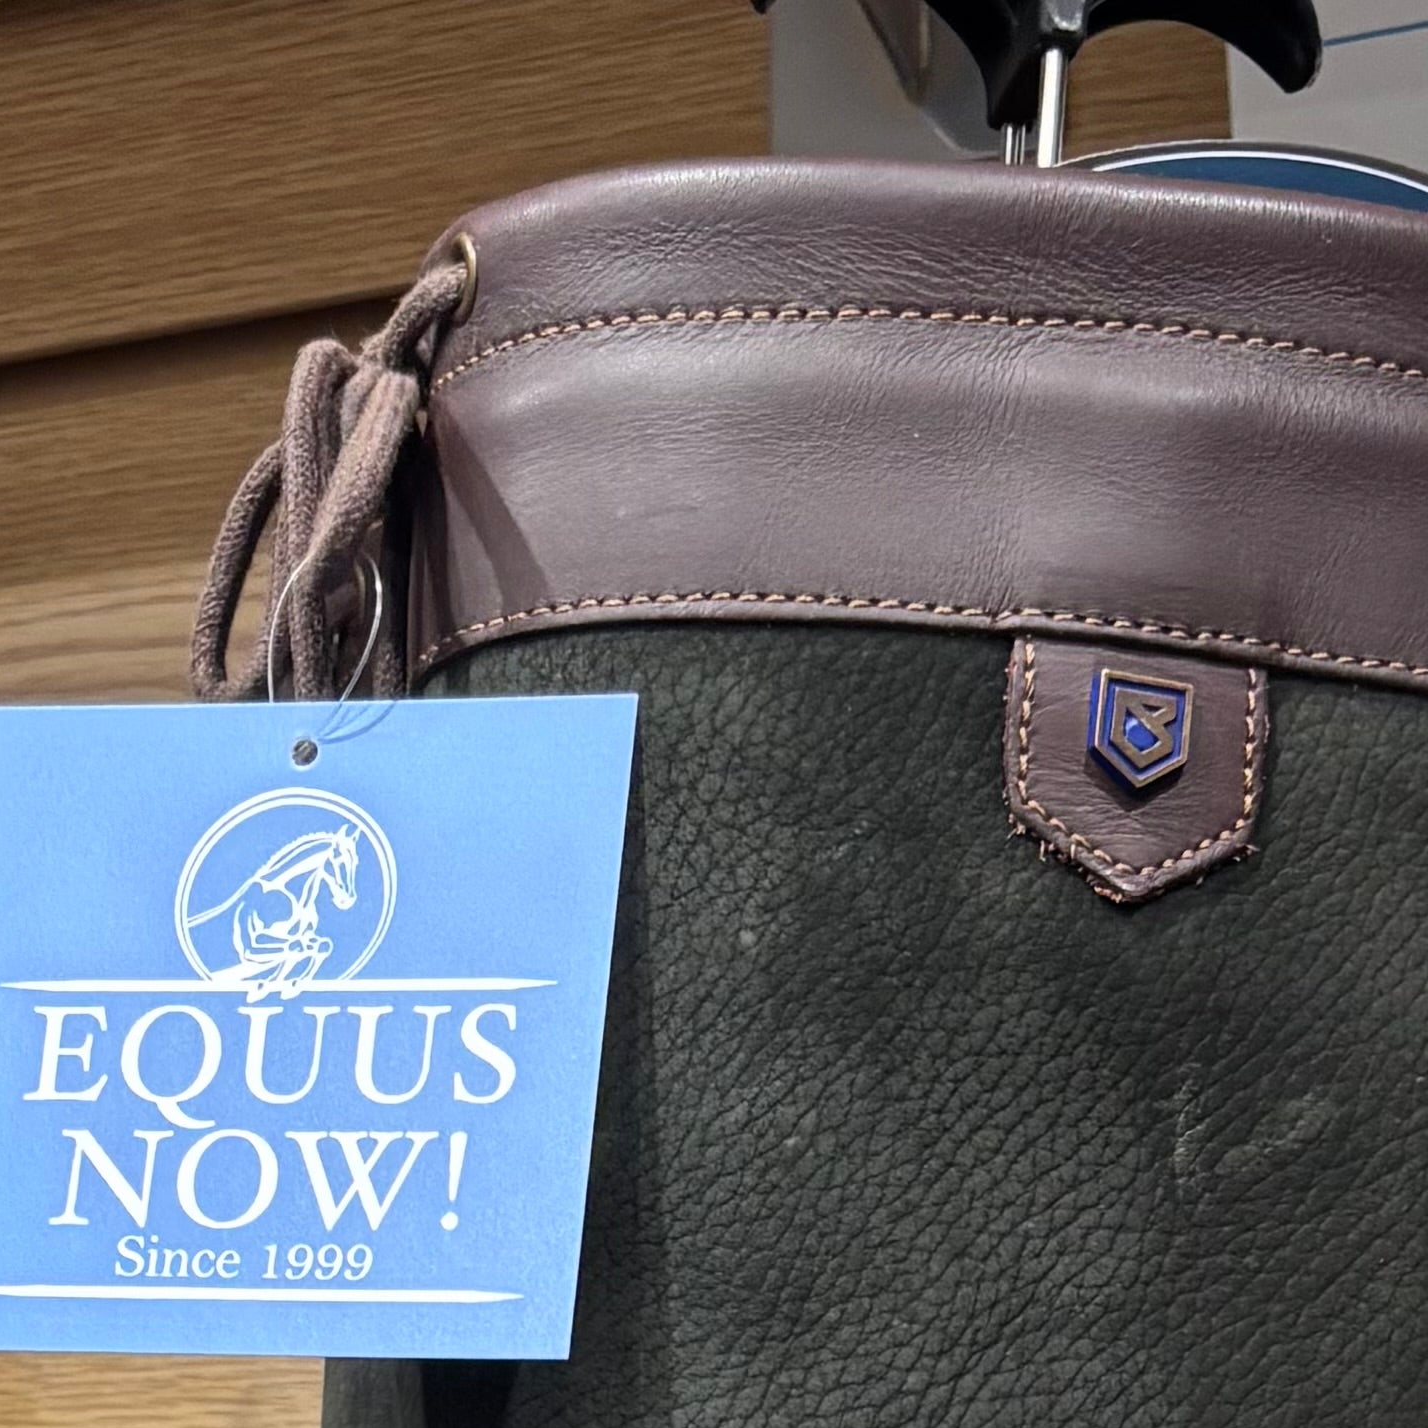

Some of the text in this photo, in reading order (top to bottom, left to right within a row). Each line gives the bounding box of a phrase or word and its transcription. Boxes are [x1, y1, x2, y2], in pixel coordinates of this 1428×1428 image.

[23, 1004, 517, 1130] EQUUS
[48, 1129, 468, 1231] NOW!
[114, 1235, 374, 1281] Since 1999
